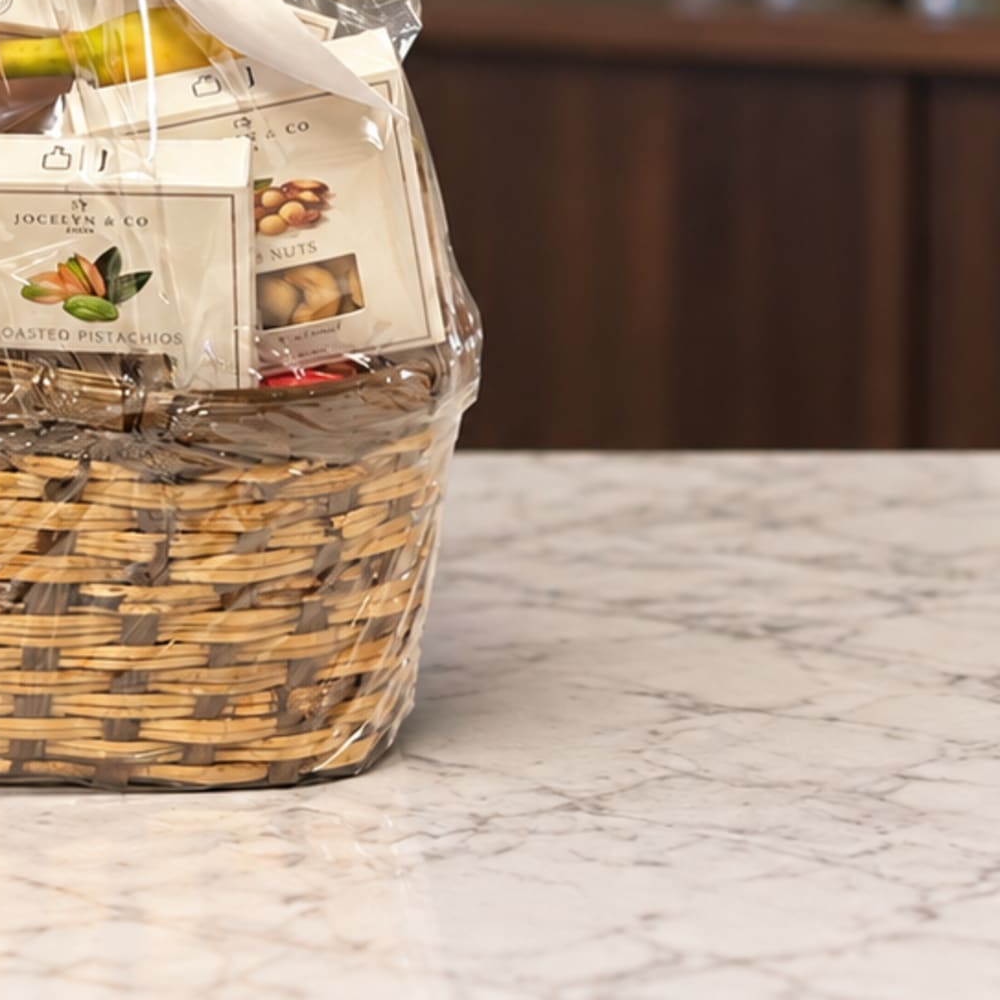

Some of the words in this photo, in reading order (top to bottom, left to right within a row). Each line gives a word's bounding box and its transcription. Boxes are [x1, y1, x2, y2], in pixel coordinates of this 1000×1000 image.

[285, 121, 310, 134] CO
[14, 213, 96, 226] JOCELYN
[104, 216, 115, 227] &
[123, 215, 149, 227] CO
[270, 240, 318, 261] NUTS
[78, 329, 183, 345] PISTACHIOS
